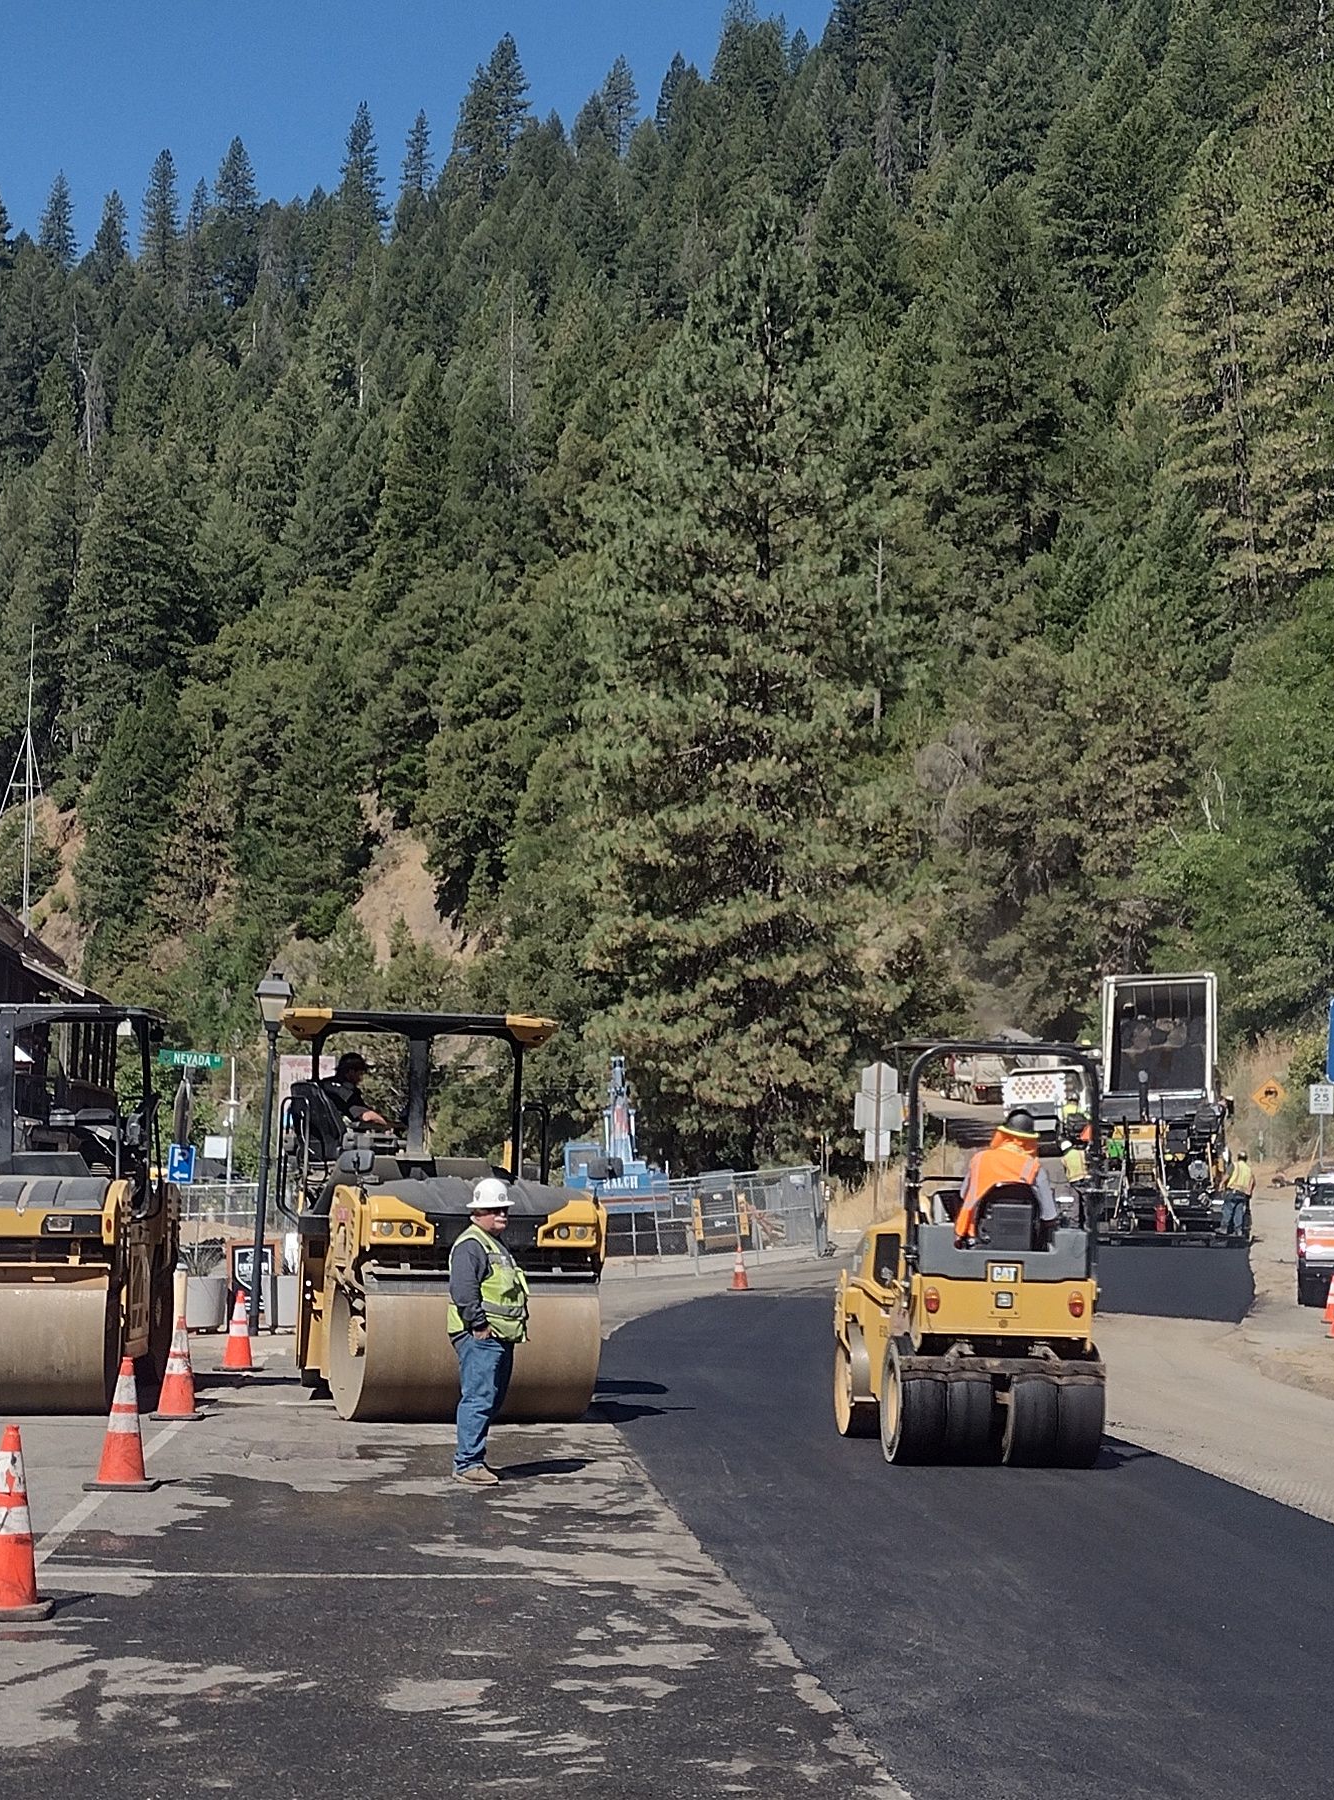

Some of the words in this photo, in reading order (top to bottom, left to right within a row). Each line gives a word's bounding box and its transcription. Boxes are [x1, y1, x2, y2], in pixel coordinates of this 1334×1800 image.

[173, 1052, 211, 1067] NEVADA
[1313, 1093, 1330, 1103] 25
[173, 1148, 190, 1168] P
[993, 1266, 1017, 1282] CAT
